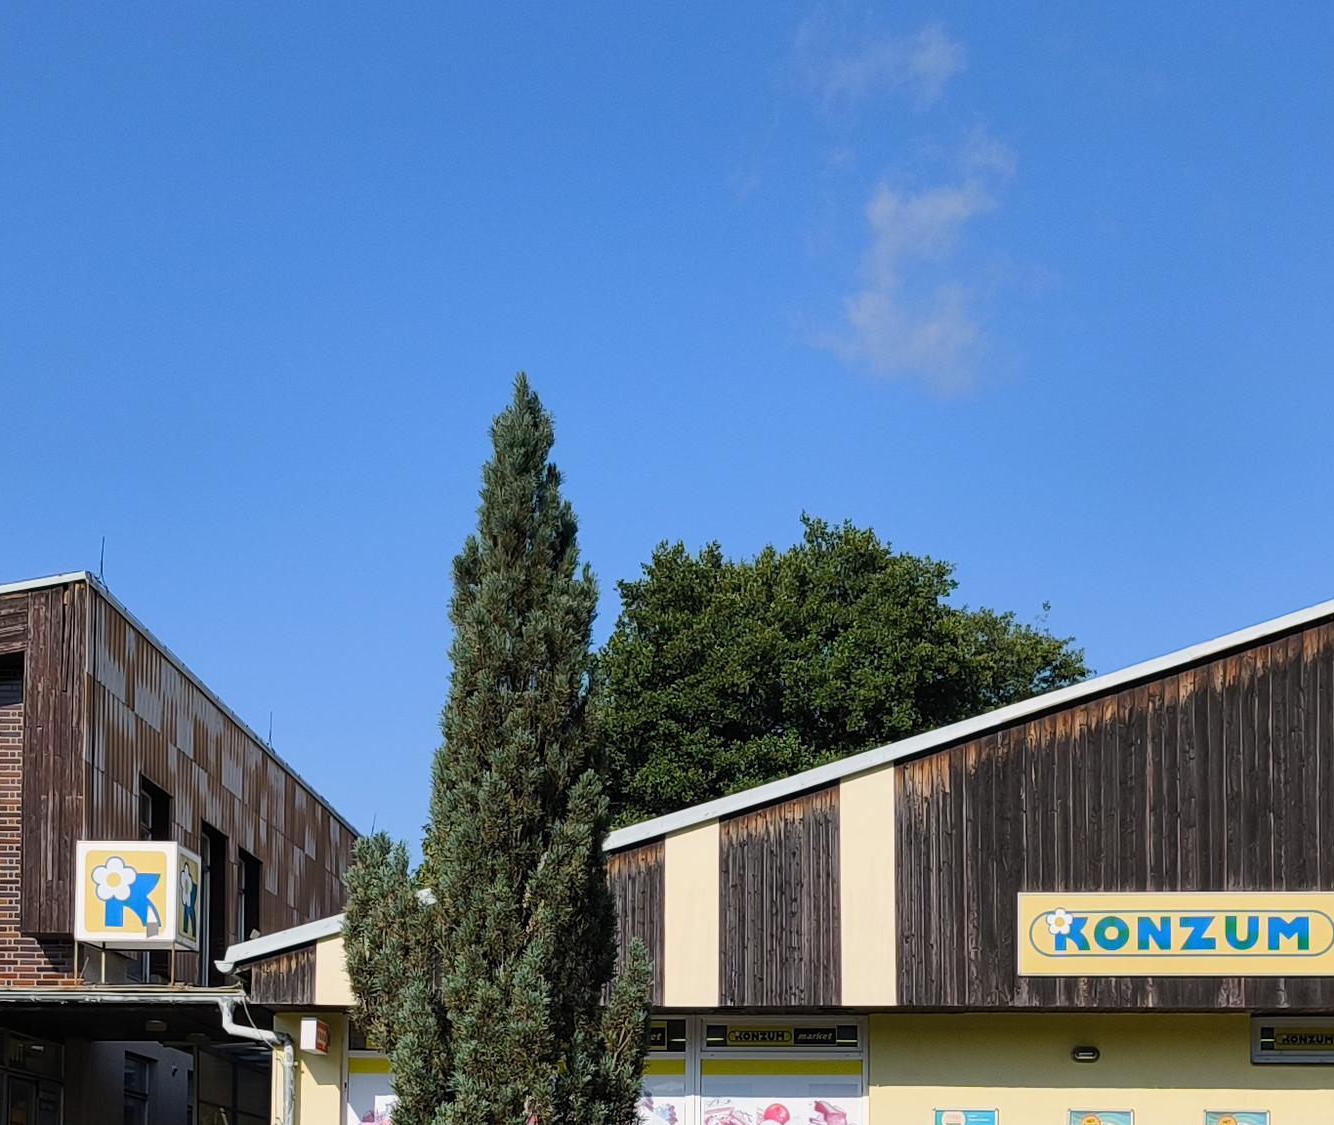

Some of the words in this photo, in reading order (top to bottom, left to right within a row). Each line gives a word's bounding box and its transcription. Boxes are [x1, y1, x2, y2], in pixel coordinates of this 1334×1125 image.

[1051, 914, 1311, 951] KONZUM
[735, 1030, 785, 1042] KONZUM
[797, 1031, 833, 1041] market
[1281, 1034, 1334, 1044] KONZUM
